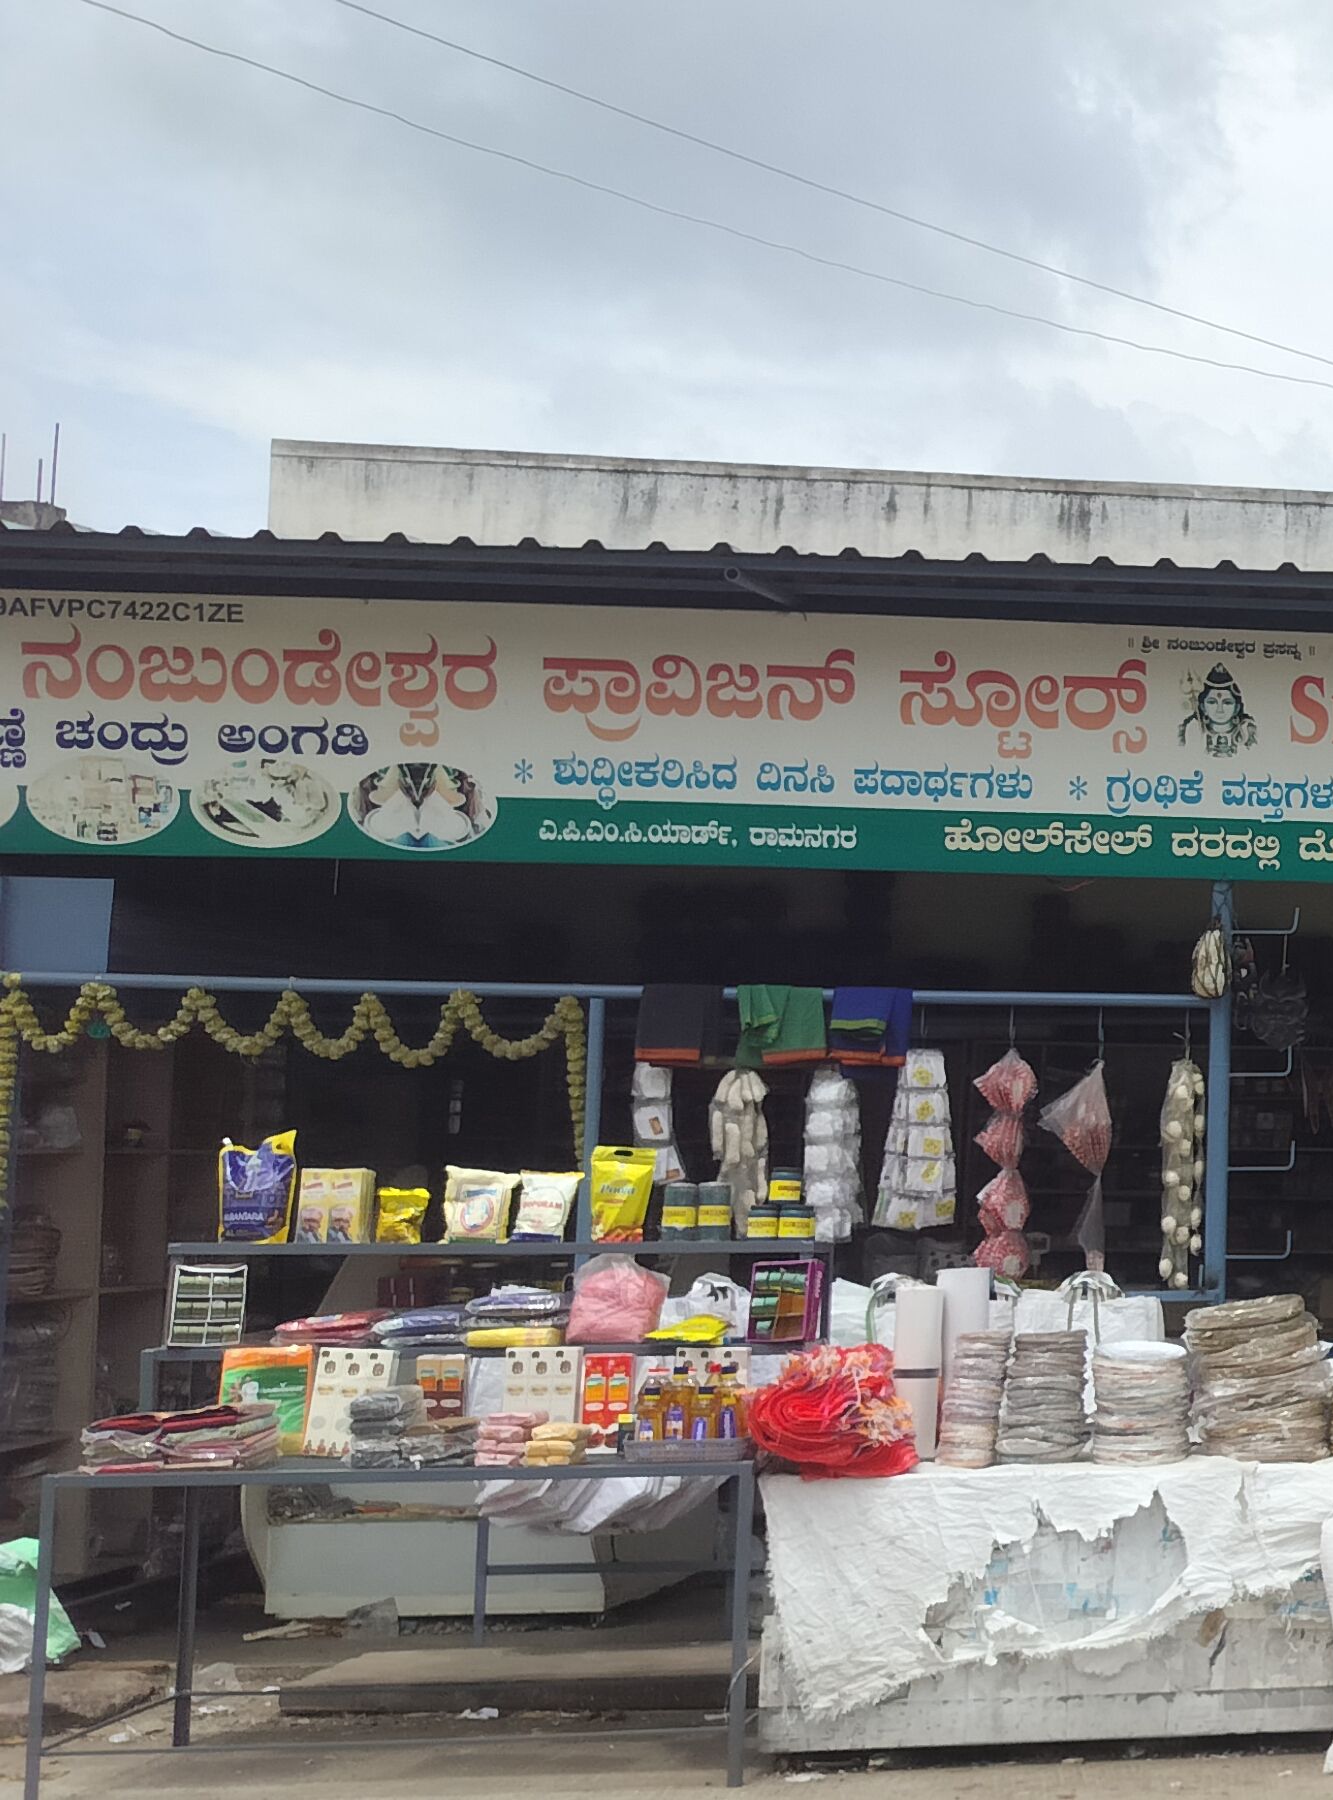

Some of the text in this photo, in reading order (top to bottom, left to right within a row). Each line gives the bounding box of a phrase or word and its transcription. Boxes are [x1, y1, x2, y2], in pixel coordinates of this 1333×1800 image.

[1140, 635, 1160, 654] ಶ್ರೀ
[20, 623, 497, 748] ನಂಜುಂಡೇಶ್ವರ
[542, 647, 856, 742] ಪ್ರಾವಿಜನ್
[55, 710, 190, 765] ಚಂದ್ರು
[217, 716, 370, 756] ಅಂಗಡಿ
[552, 752, 738, 810] ಶುದ್ಧೀಕರಿಸಿದ
[757, 758, 835, 795] ದಿನಸಿ
[853, 760, 1033, 802] ಪದಾರ್ಥಗಳು
[748, 822, 857, 851] ರಾಮನಗರ
[1170, 829, 1281, 871] ದರದಲ್ಲಿ
